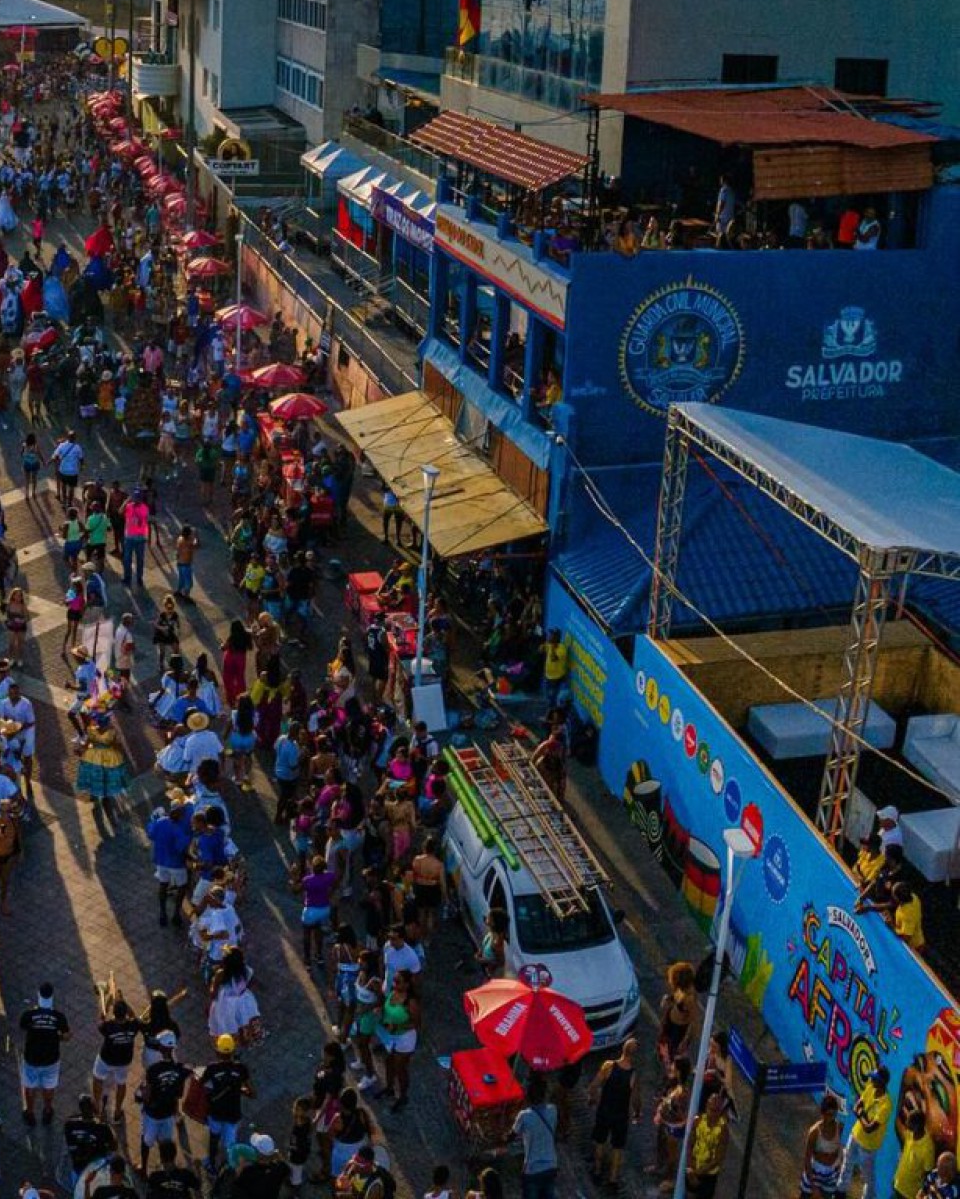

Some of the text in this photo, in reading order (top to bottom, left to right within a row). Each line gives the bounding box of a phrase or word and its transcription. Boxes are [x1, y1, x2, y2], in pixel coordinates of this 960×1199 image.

[628, 291, 739, 355] GUARDA CIVIL MUNICIPAL
[785, 361, 903, 389] SALVADOR
[801, 383, 885, 402] PREFEITURA
[831, 908, 872, 963] SALVADOR
[803, 908, 890, 1054] CAPITAL
[788, 957, 881, 1100] AFRO
